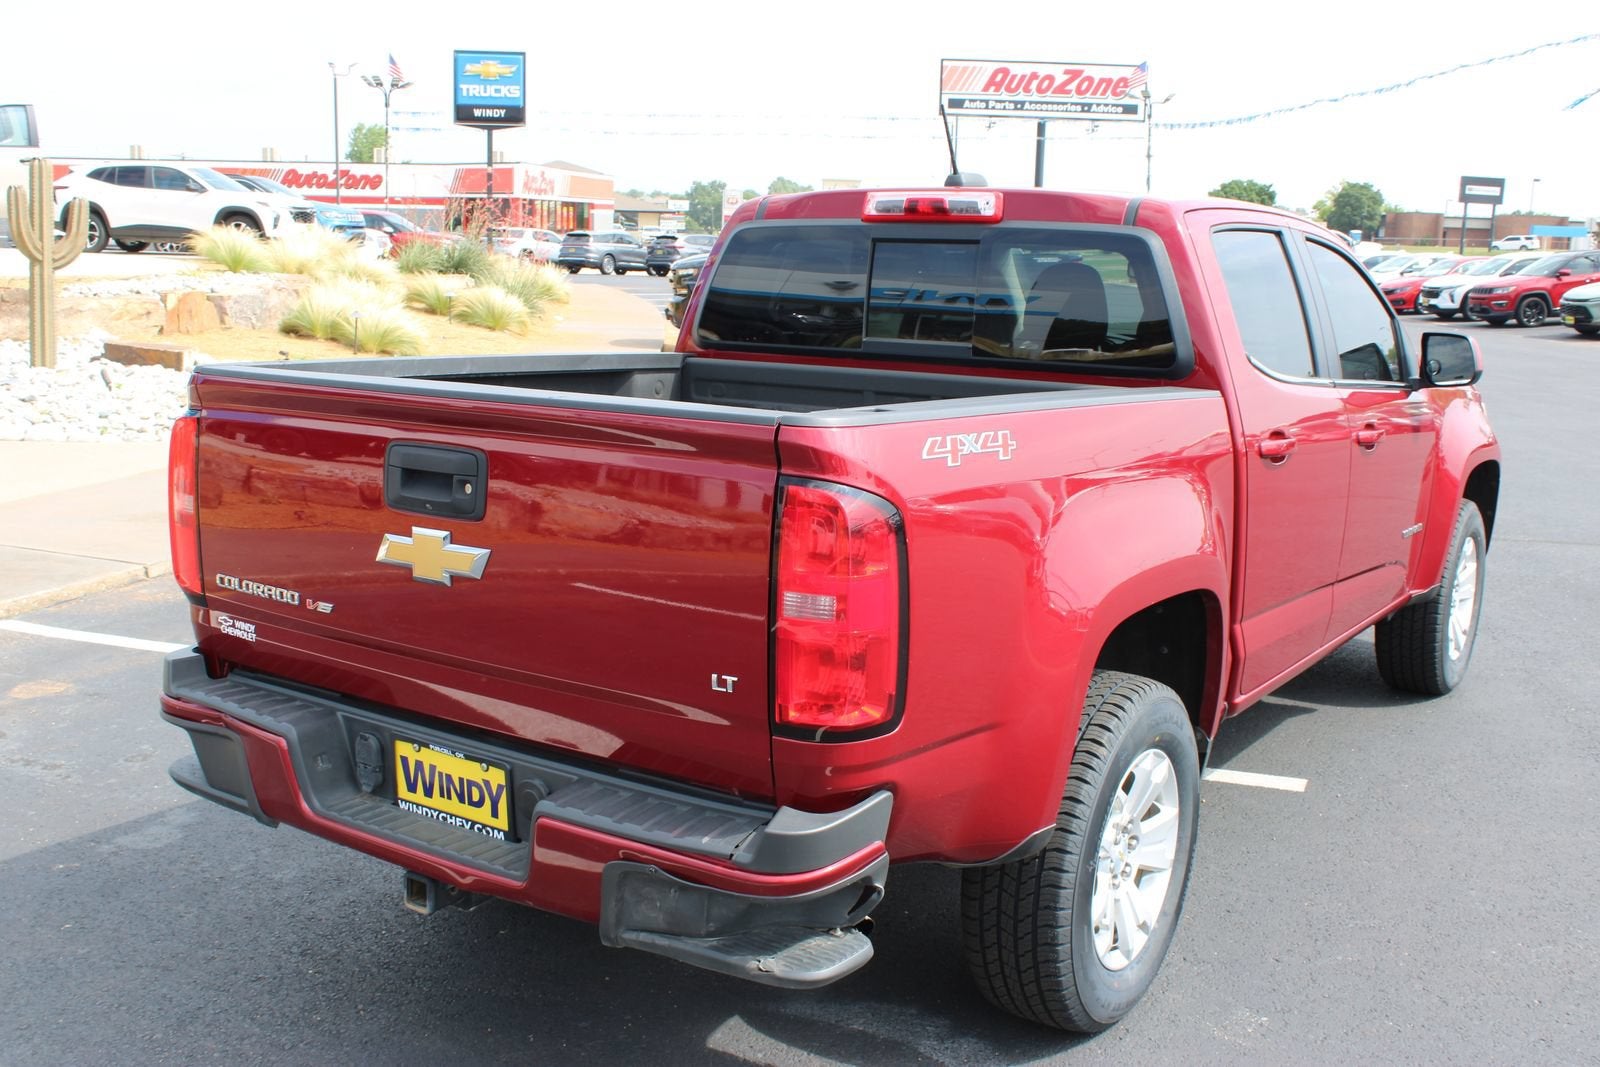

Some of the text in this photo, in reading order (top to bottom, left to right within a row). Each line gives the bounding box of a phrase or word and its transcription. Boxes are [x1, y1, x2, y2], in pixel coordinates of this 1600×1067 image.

[459, 84, 521, 97] TRUCKS
[981, 67, 1130, 99] AutoZone
[473, 108, 506, 118] WINDY
[963, 100, 1123, 113] Auto Parts Accessories Advice
[280, 168, 383, 190] AutoZone
[215, 573, 334, 614] COLORADO V6
[220, 625, 256, 642] CHEVROLET
[234, 619, 256, 633] WINDY
[711, 673, 738, 693] LT
[400, 754, 506, 819] WINDY
